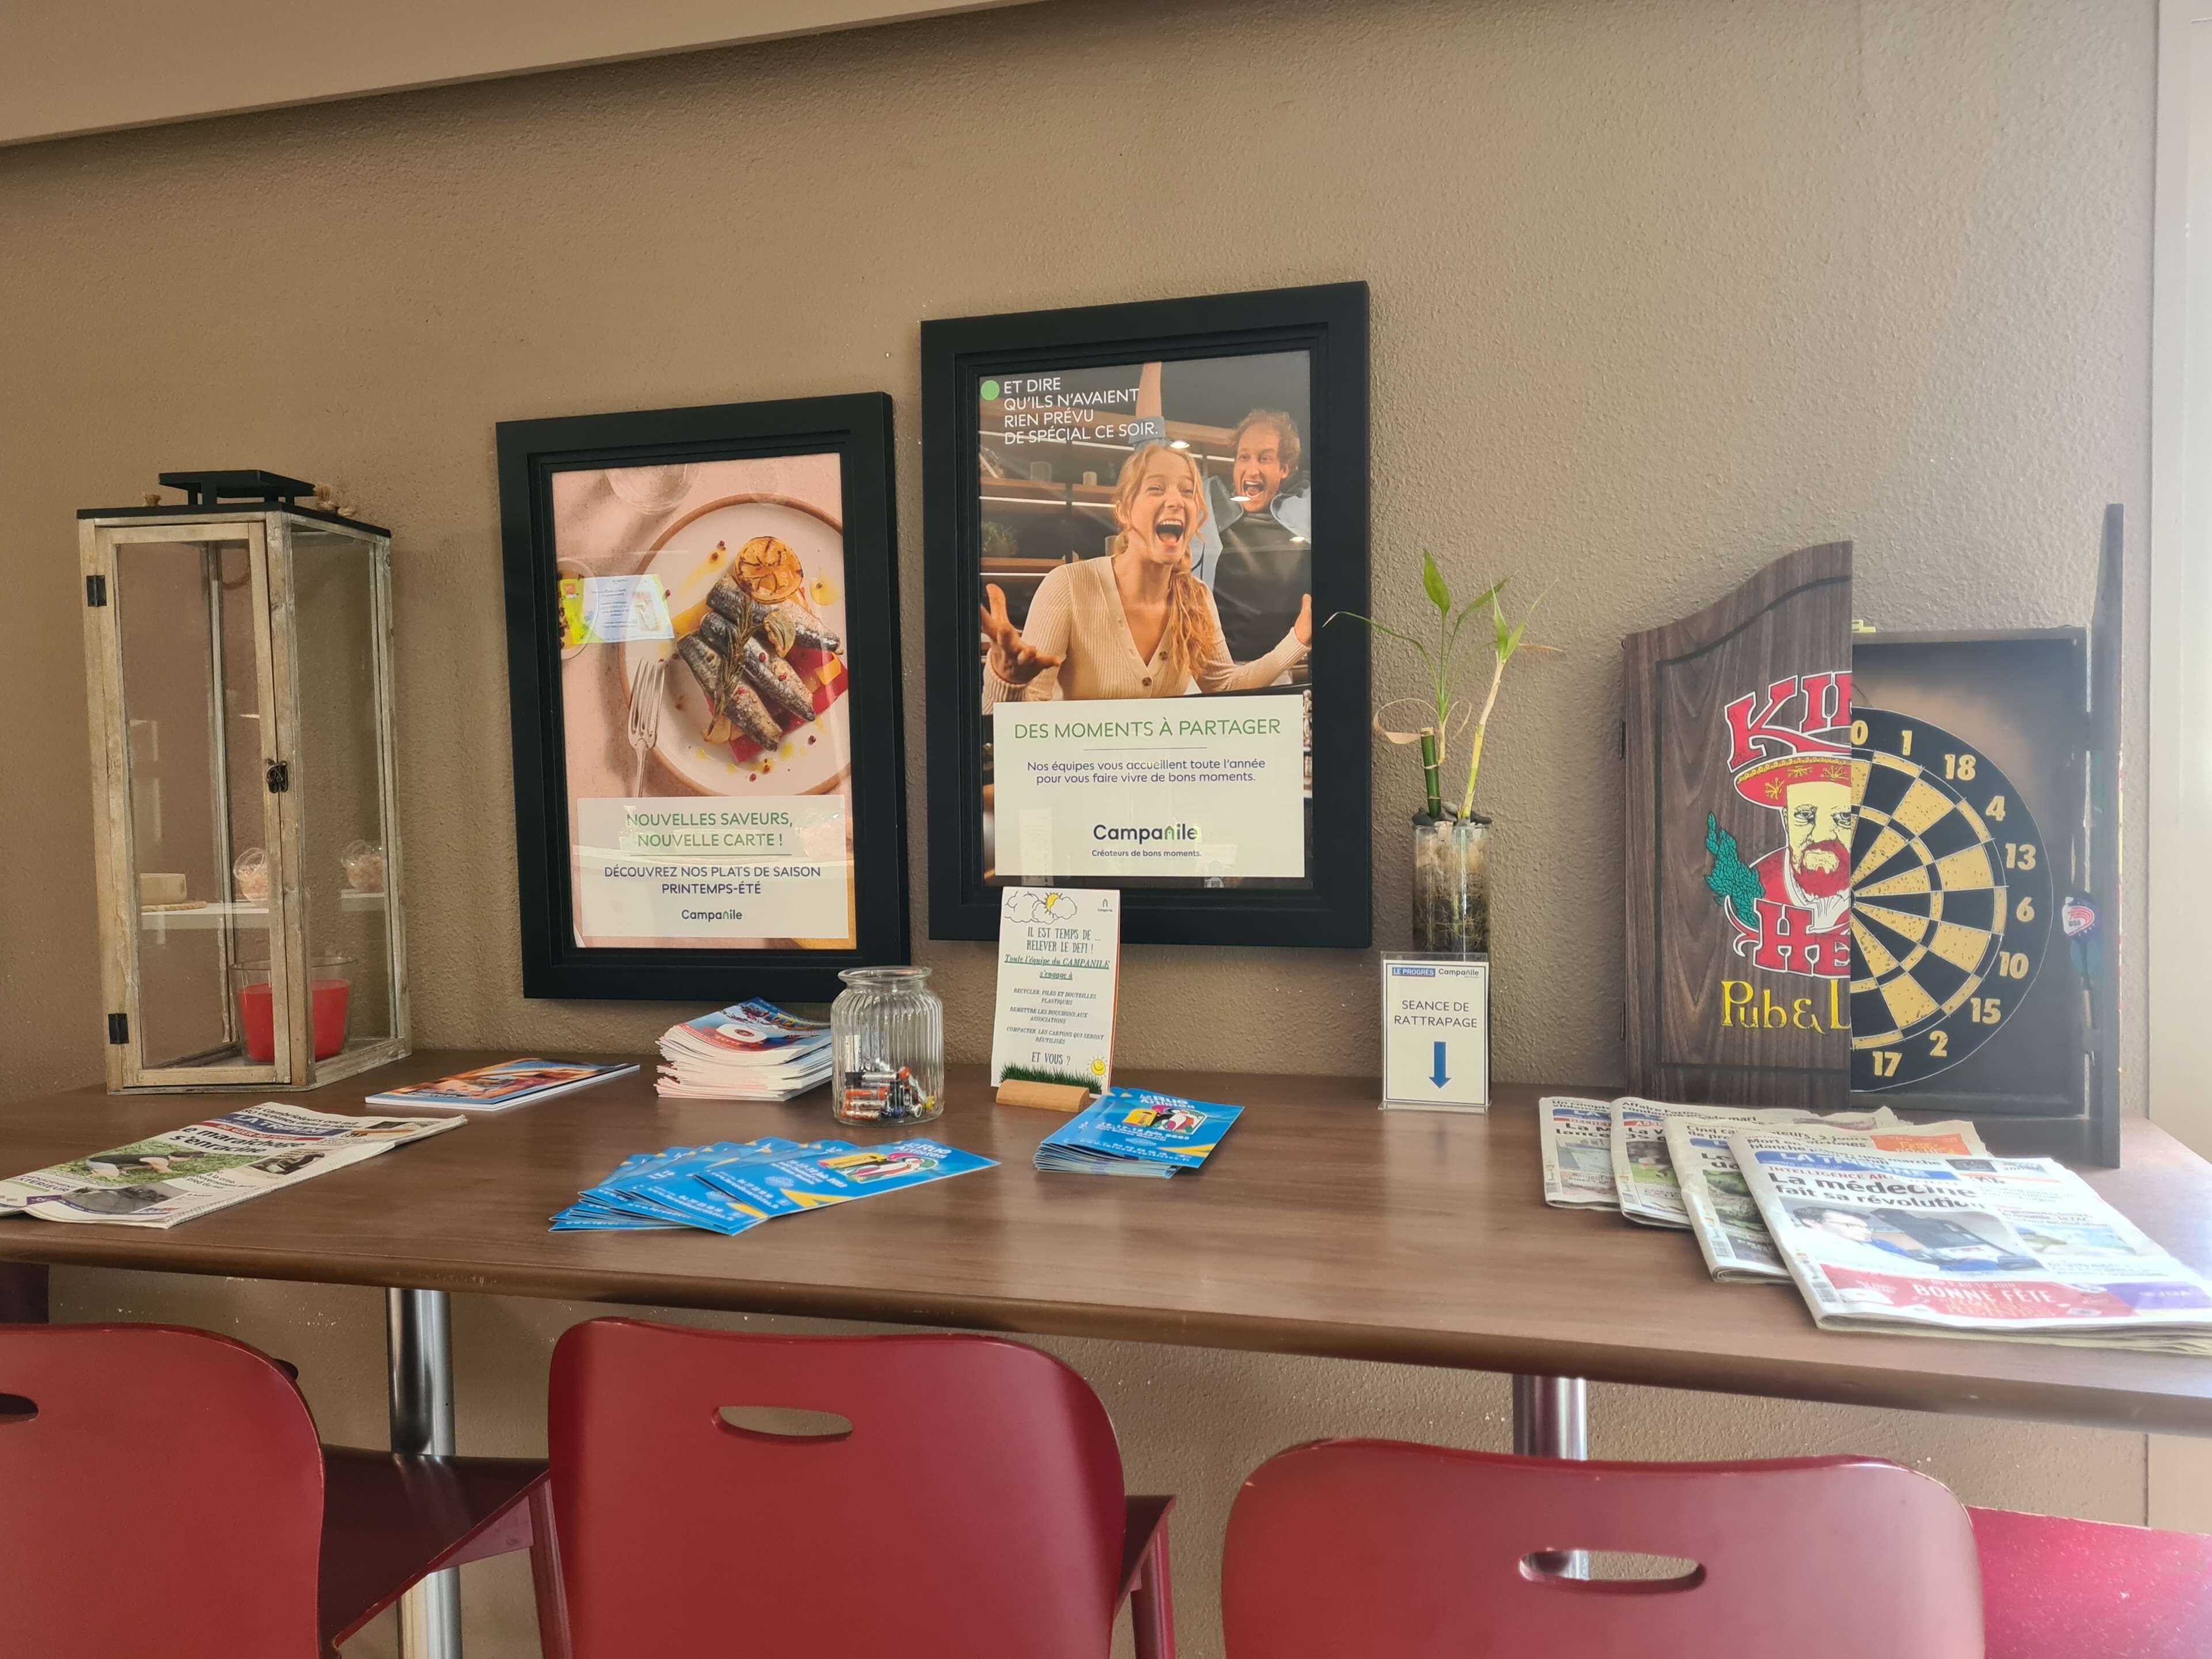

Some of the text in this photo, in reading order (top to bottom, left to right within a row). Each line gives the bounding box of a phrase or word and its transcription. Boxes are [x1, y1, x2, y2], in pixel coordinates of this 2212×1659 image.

[1005, 377, 1061, 394] ET DIRE
[1005, 388, 1140, 411] QU'ILS N'AVAIENT
[1005, 407, 1094, 427] RIEN PRÉVU
[1005, 422, 1158, 445] DE SPÉCIAL CE SOIR.
[1014, 717, 1281, 739] DES MOMENTS À PARTAGER
[1902, 730, 1913, 756] 1
[1027, 758, 1266, 773] Nos équipes vous accueillent toute l'année
[1944, 753, 1977, 781] 18
[1036, 772, 1256, 786] pour vous faire vivre de bons moments.
[1985, 796, 2006, 821] 4
[627, 812, 793, 827] NOUVELLES SAVEURS,
[638, 834, 719, 847] NOUVELLE
[724, 833, 774, 846] CARTE
[1093, 823, 1198, 845] Campanile
[1092, 849, 1129, 858] Créateurs
[1131, 849, 1141, 857] de
[1143, 849, 1161, 857] bons
[2005, 843, 2036, 870] 13
[604, 865, 821, 877] DÉCOUVREZ NOS PLATS DE SAISON
[662, 881, 762, 894] PRINTEMPS-ÉTÉ
[681, 909, 743, 922] Campanile
[2016, 896, 2035, 922] 6
[1028, 927, 1092, 940] IL EST TEMPS DE
[1027, 940, 1057, 952] RELEVER
[1060, 942, 1069, 953] LE
[1004, 954, 1024, 963] Toute
[1025, 955, 1050, 966] l'équipe
[1063, 958, 1111, 969] CAMPANILE
[1999, 951, 2029, 979] 10
[1438, 968, 1479, 978] Campanile
[1402, 1000, 1469, 1012] SEANCE DE
[1969, 998, 2001, 1025] 15
[1029, 1016, 1066, 1024] ASSOCIATIONS
[1394, 1015, 1478, 1028] RATTRAPAGE
[1929, 1030, 1949, 1058] 2
[1032, 1052, 1041, 1063] ET
[1044, 1053, 1063, 1065] VOUS
[1872, 1051, 1903, 1078] 17
[1780, 1152, 1815, 1163] LA
[1768, 1166, 1863, 1180] INTELLIGENCE
[1767, 1172, 1806, 1185] La
[1816, 1179, 1978, 1198] médecine
[1775, 1184, 1818, 1198] fait
[1825, 1191, 1850, 1201] sa
[1856, 1193, 1986, 1209] révolution
[1912, 1283, 1997, 1302] BONNE
[2000, 1287, 2057, 1303] FÊTE
